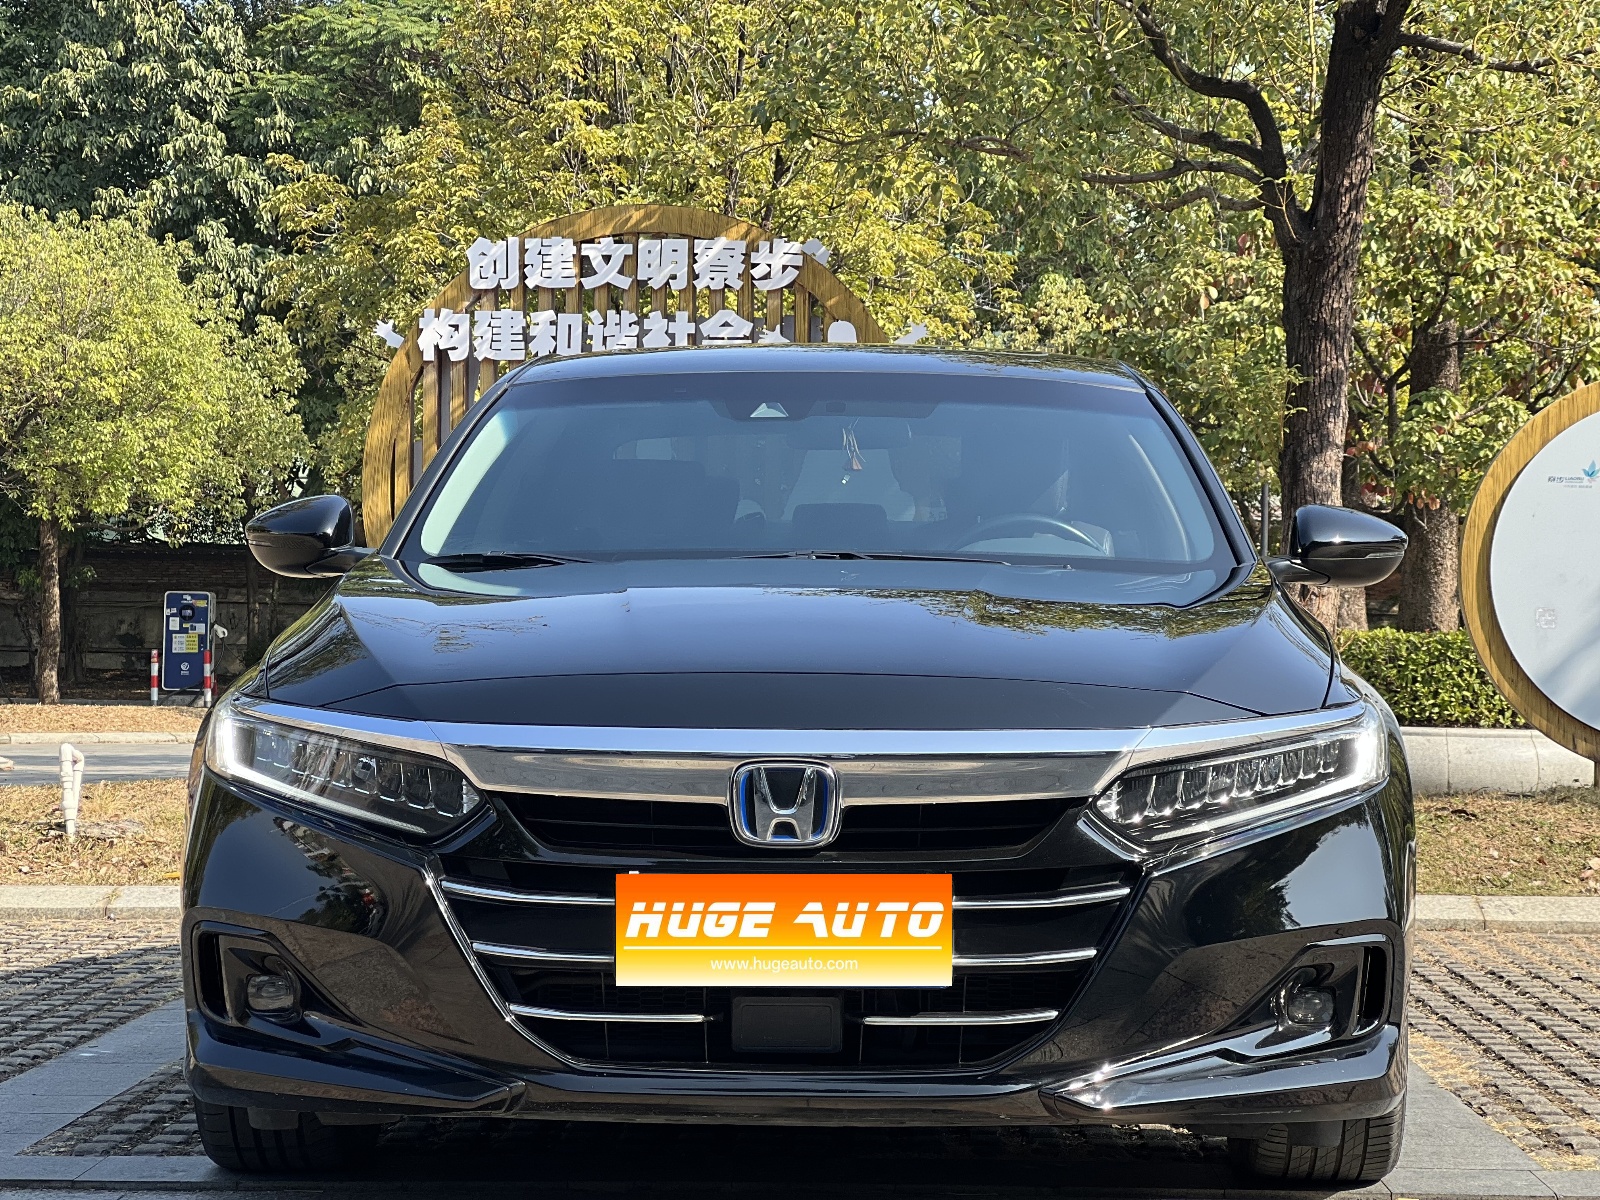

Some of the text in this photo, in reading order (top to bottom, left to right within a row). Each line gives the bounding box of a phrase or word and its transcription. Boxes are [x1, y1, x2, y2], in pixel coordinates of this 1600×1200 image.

[466, 237, 803, 291] 创建文明寮步
